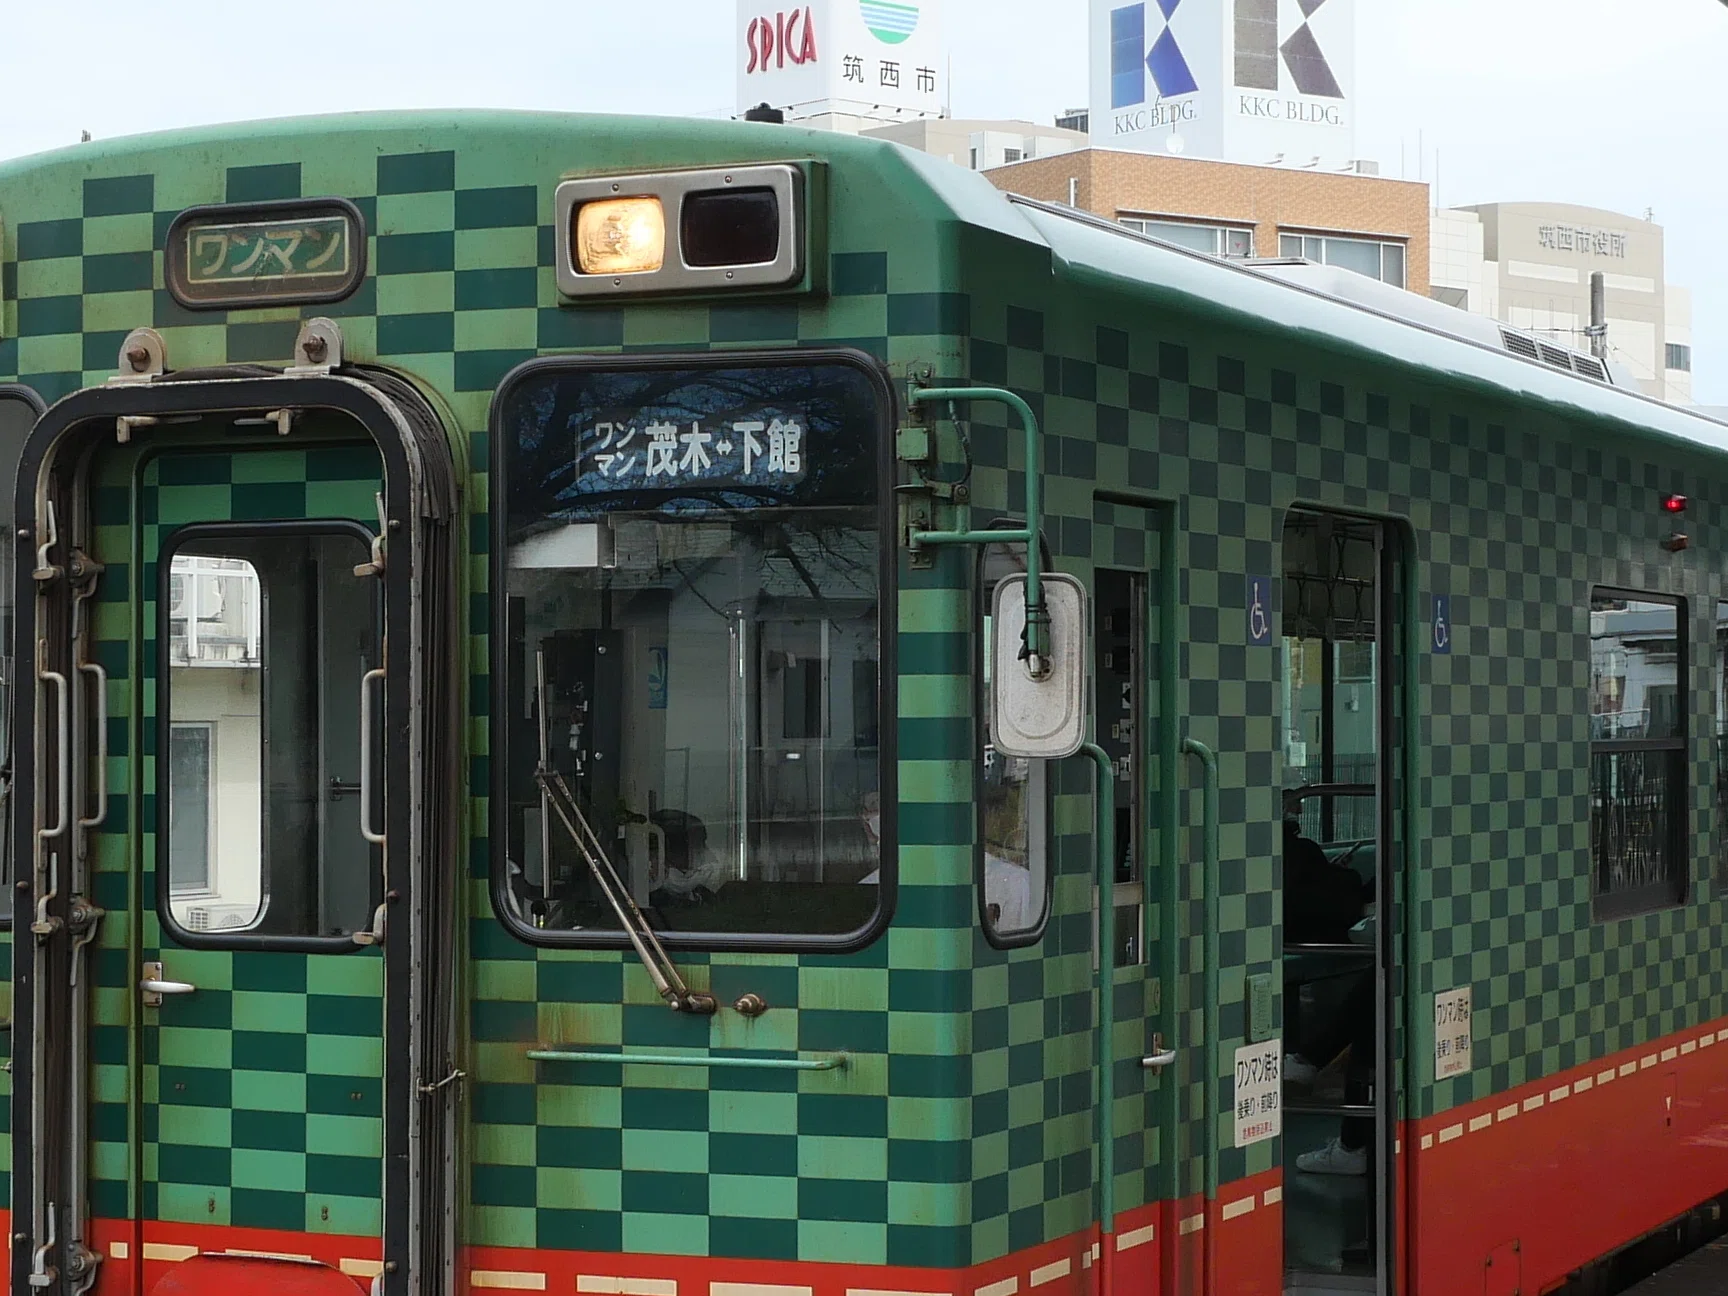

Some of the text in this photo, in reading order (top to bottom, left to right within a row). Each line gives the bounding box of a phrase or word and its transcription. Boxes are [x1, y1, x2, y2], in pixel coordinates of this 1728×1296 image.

[747, 6, 817, 74] SPICA
[842, 54, 936, 93] 筑西市
[1114, 110, 1146, 135] KKC
[1240, 95, 1281, 119] KKC
[195, 227, 341, 276] ワンマン
